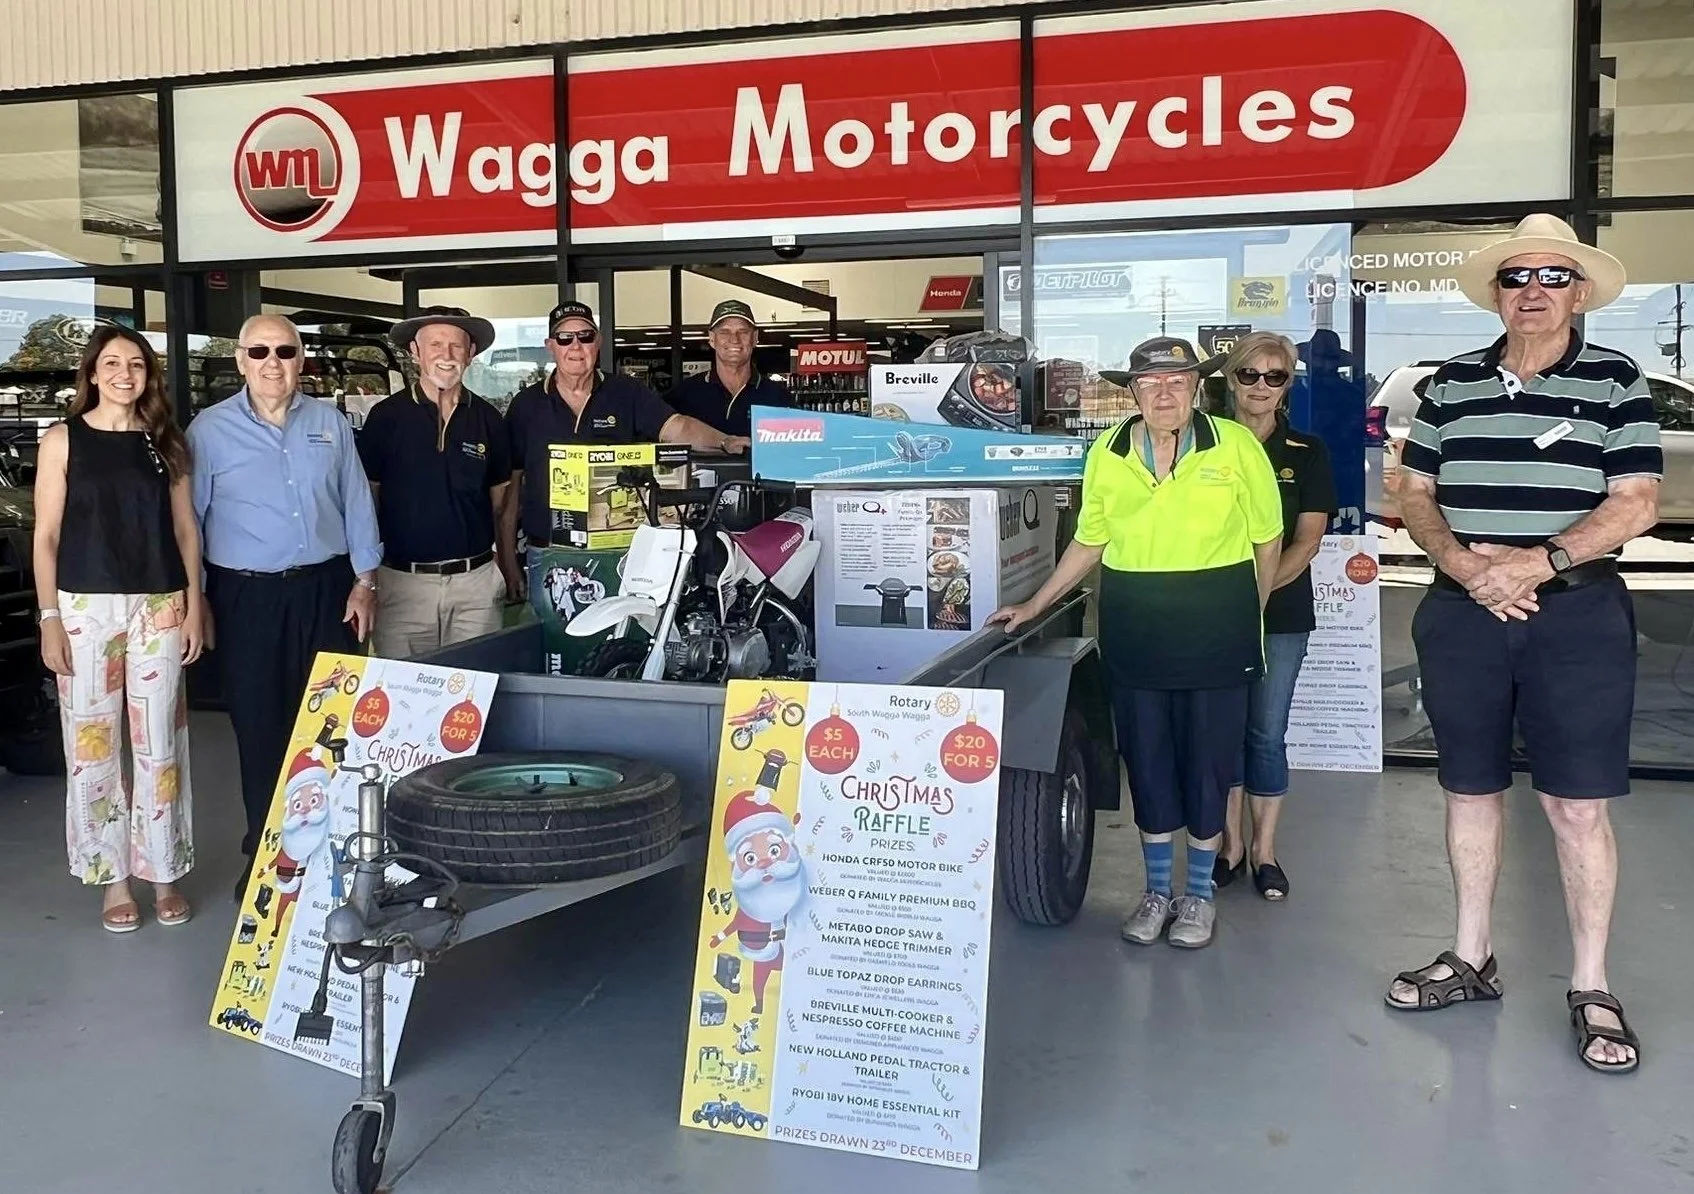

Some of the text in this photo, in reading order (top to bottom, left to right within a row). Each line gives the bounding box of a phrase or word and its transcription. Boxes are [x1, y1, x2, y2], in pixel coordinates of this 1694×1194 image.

[384, 76, 1355, 206] Wagga Motorcycles
[1393, 250, 1464, 269] MOTOR
[930, 288, 962, 298] Honda
[1305, 279, 1388, 298] LICENCE
[800, 349, 866, 366] MOTUL
[885, 371, 939, 386] Breville
[757, 428, 824, 443] makita
[589, 452, 614, 463] RYOBI
[1313, 582, 1356, 602] ISTMAS
[1316, 602, 1344, 613] FFLE
[416, 672, 447, 688] Rotary
[365, 697, 381, 710] $5
[889, 695, 931, 709] Rotary
[353, 711, 385, 726] EACH
[451, 710, 475, 724] $20
[871, 710, 899, 719] Wagga
[902, 711, 930, 720] Wagga
[441, 726, 477, 742] FOR 5
[823, 727, 842, 742] $5
[953, 733, 985, 749] $20
[809, 745, 854, 759] EACH
[943, 753, 995, 768] FOR 5
[841, 775, 954, 815] CHRISTMAS
[853, 806, 931, 835] RAFFLE
[822, 854, 859, 864] HONDA
[897, 859, 935, 870] MOTOR
[938, 863, 963, 873] BIKE
[311, 900, 330, 911] BLUE
[808, 885, 976, 910] WEBER Q FAMILY PREMIUM BBQ
[828, 921, 943, 940] METABO DROP SAW &
[821, 934, 952, 955] MAKITA HEDGE TRIMMER
[286, 964, 304, 975] NEW
[336, 979, 360, 992] PEDAL
[807, 966, 833, 977] BLUE
[836, 970, 871, 982] TOPAZ
[874, 974, 904, 985] DROP
[907, 977, 962, 992] EARRINGS
[810, 1000, 953, 1024] BREVILLE MULTI-COOKER &
[335, 1019, 362, 1033] ESSENT
[801, 1013, 863, 1028] NESPRESSO
[865, 1020, 906, 1033] COFFEE
[909, 1026, 960, 1039] MACHINE
[263, 1031, 291, 1048] PRIZES
[290, 1040, 322, 1058] DRAWN
[339, 1057, 362, 1072] DECE
[789, 1044, 970, 1075] NEW HOLLAND PEDAL TRACTOR &
[854, 1066, 898, 1080] TRAILER
[792, 1087, 823, 1100] RYOBI
[826, 1092, 844, 1103] 18V
[847, 1095, 879, 1108] HOME
[882, 1100, 940, 1116] ESSENTIAL
[943, 1108, 961, 1119] KIT
[775, 1125, 816, 1140] PRIZES
[819, 1131, 868, 1148] DRAWN
[900, 1143, 971, 1164] DECEMBER
